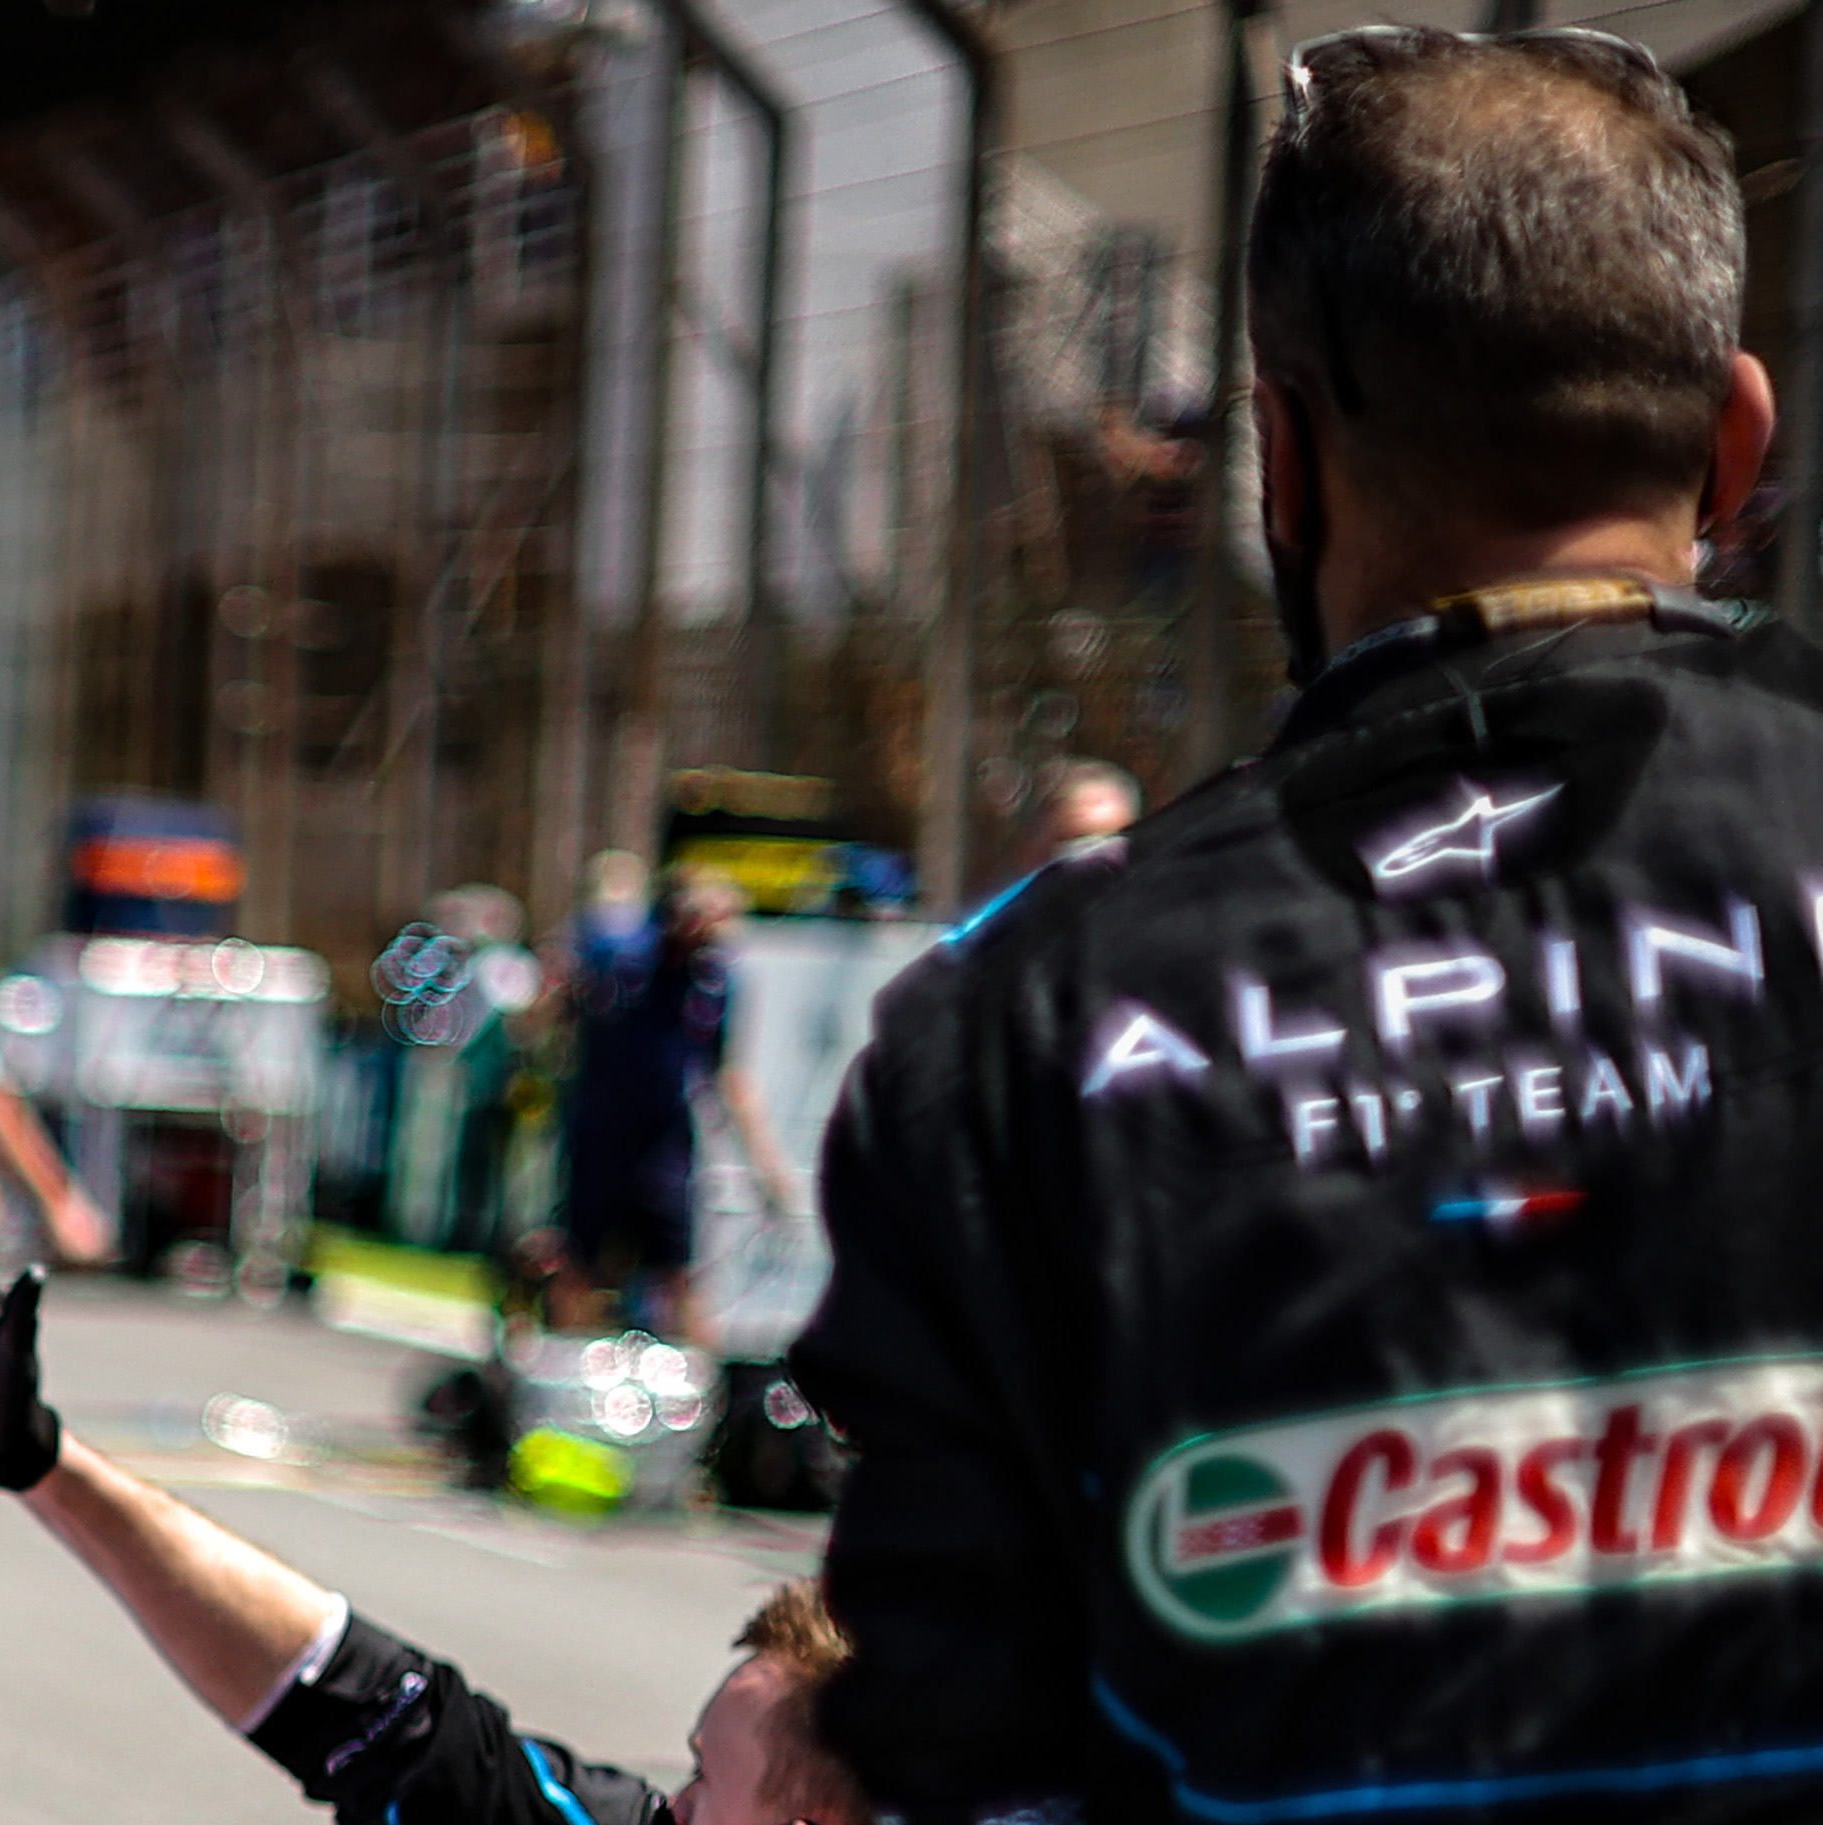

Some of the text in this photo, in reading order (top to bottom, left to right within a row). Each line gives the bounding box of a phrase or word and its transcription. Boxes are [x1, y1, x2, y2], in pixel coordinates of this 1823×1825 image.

[1081, 888, 1823, 1098] ALPIN
[1455, 1044, 1713, 1131] TEAM
[1320, 1402, 1823, 1588] Castro
